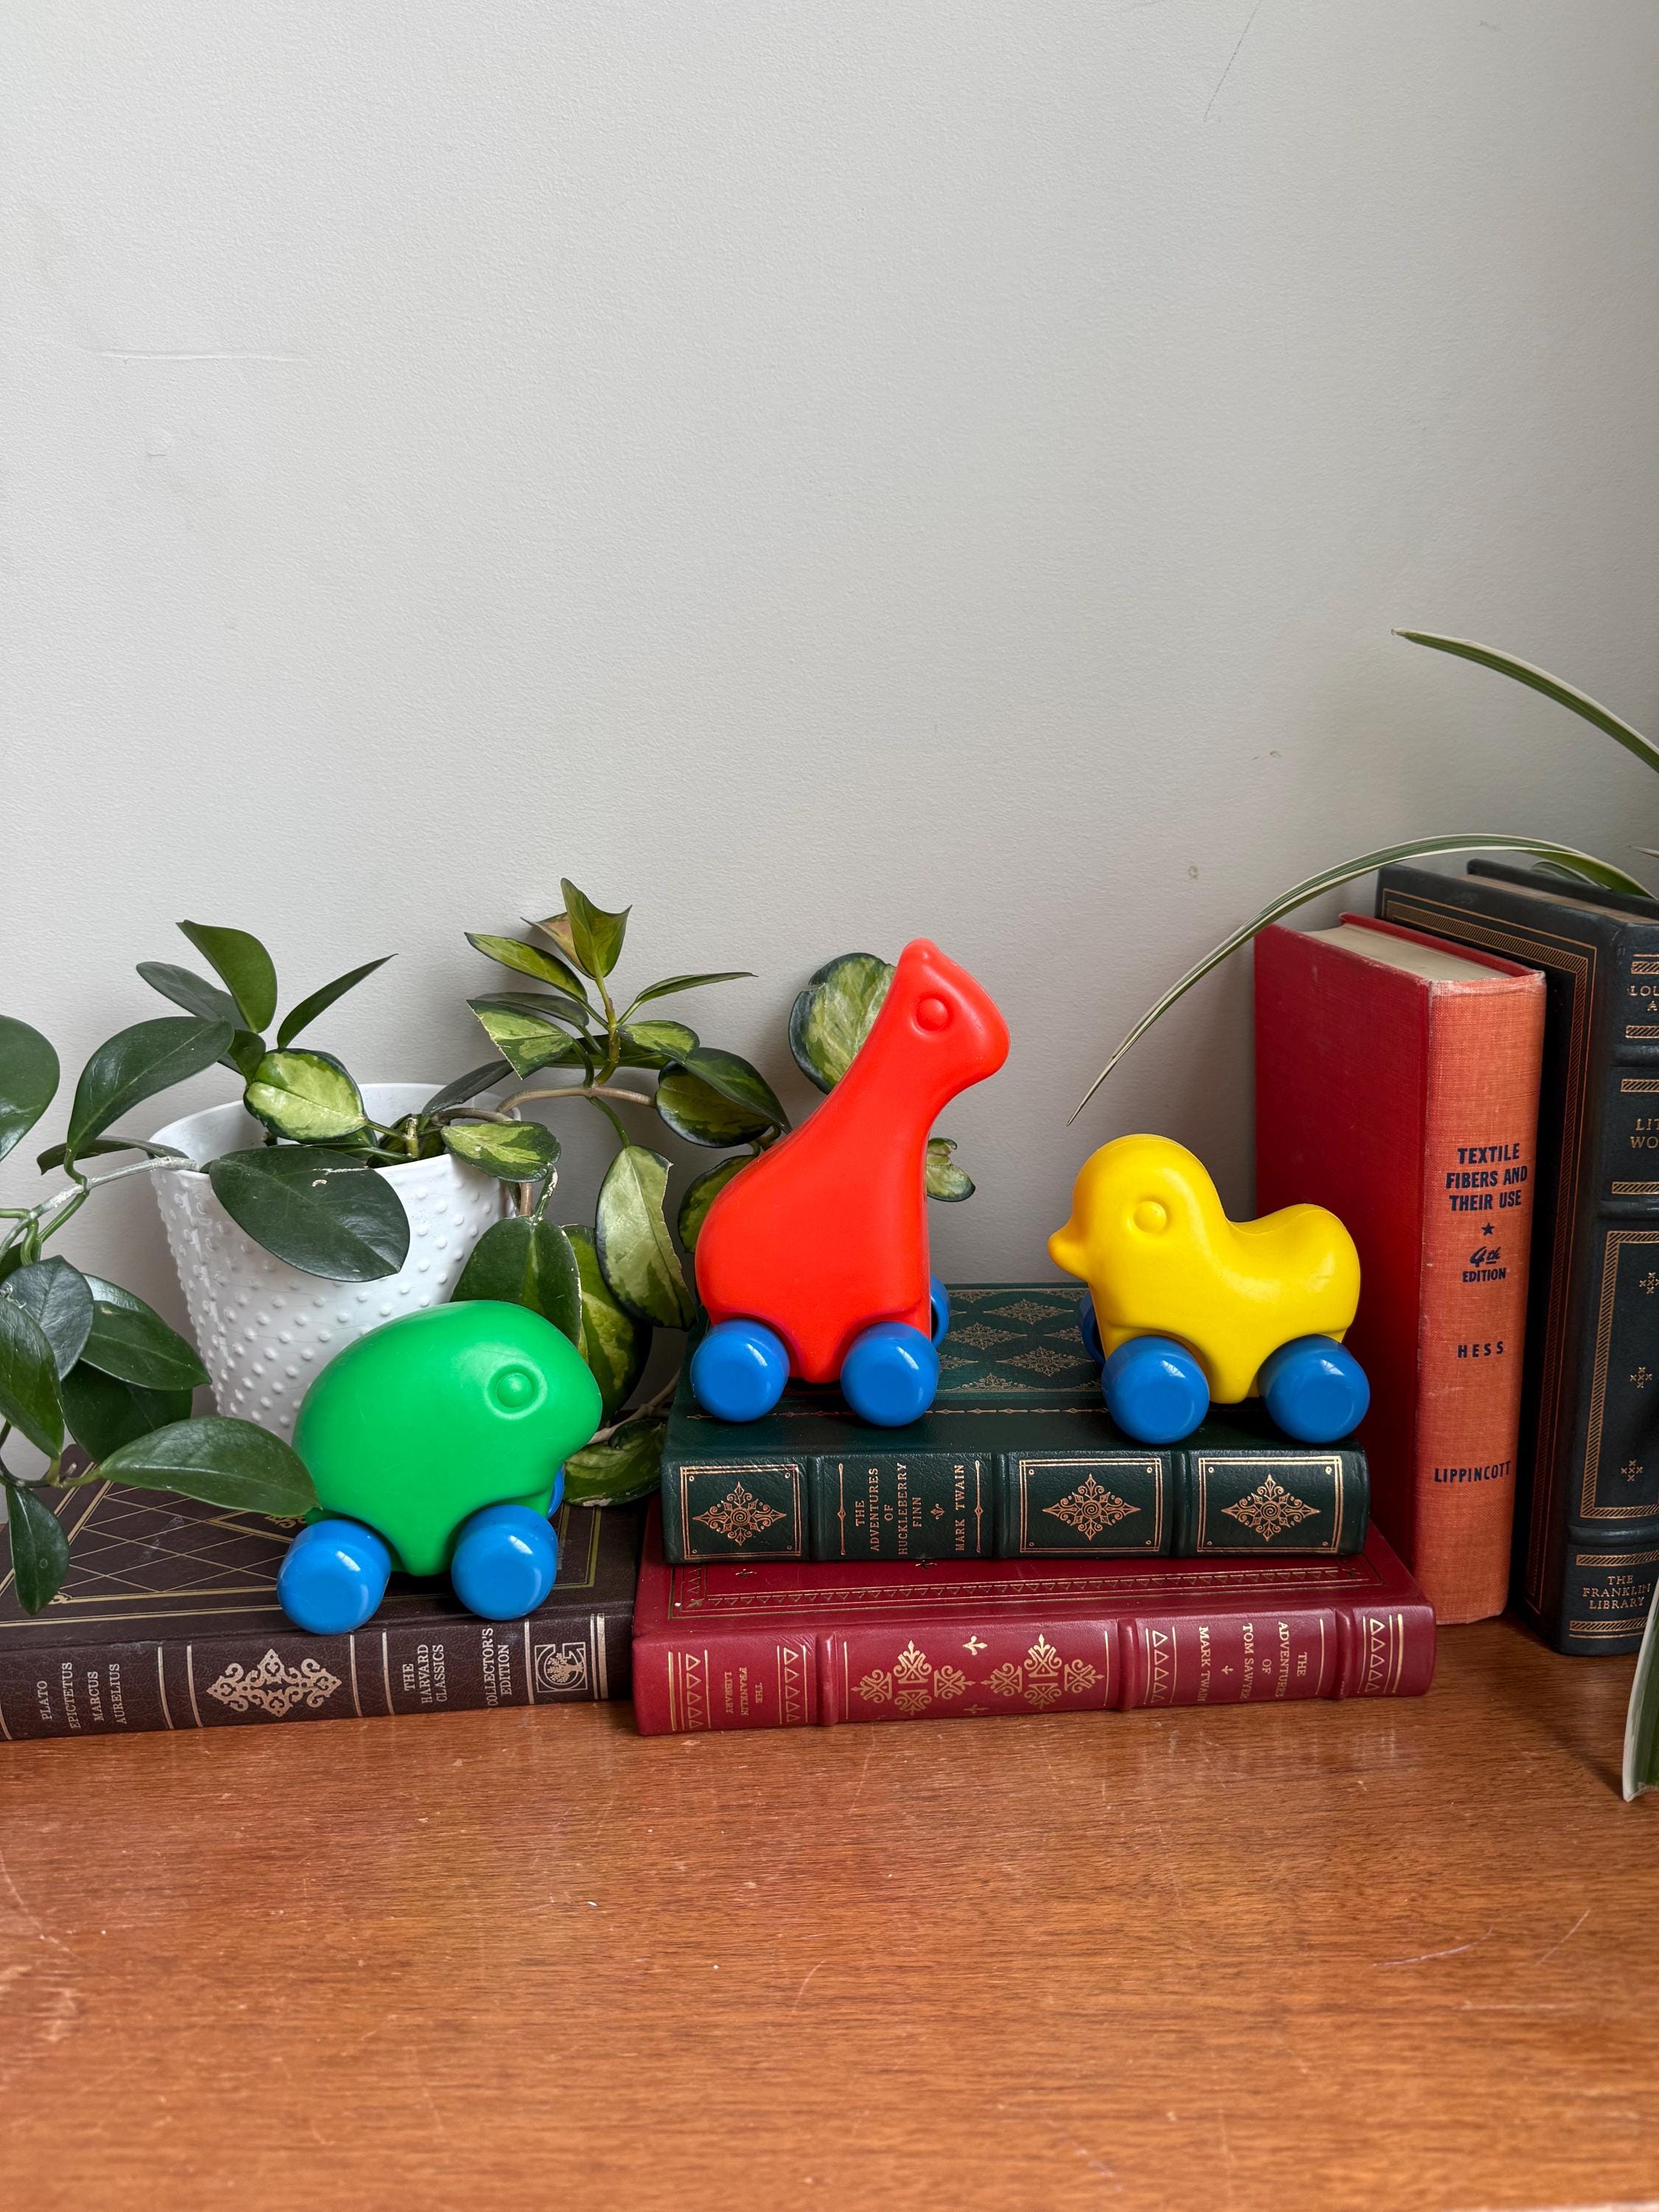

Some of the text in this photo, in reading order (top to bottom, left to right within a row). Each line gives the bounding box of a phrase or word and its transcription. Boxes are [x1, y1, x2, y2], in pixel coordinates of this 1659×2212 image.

[1457, 1143, 1520, 1164] TEXTILE
[1445, 1166, 1528, 1189] FIBERS AND
[1449, 1189, 1522, 1211] THEIR USE
[1470, 1246, 1500, 1267] 4th
[1462, 1267, 1506, 1283] EDITION
[1457, 1341, 1504, 1358] HESS
[1434, 1460, 1512, 1484] LIPPINCOTT
[855, 1500, 866, 1526] THE
[869, 1468, 879, 1551] ADVENTURES
[884, 1504, 894, 1521] OF
[897, 1462, 908, 1555] HUCKLEBERRY
[911, 1496, 922, 1528] FINN
[954, 1464, 966, 1551] MARK TWAIN
[1582, 1583, 1651, 1597] FRANKLIN
[1607, 1575, 1634, 1585] THE
[1589, 1597, 1644, 1609] LIBRARY
[1198, 1626, 1211, 1667] MARK
[1242, 1622, 1254, 1655] TOM
[403, 1663, 416, 1691] THE
[417, 1644, 434, 1704] HARVARD
[431, 1644, 448, 1703] CLASSICS
[481, 1627, 499, 1707] COLLECTOR'S
[498, 1644, 512, 1696] EDITION
[1262, 1658, 1272, 1674] OF
[1296, 1652, 1307, 1676] THE
[37, 1680, 52, 1721] PLATO
[62, 1662, 80, 1728] EPICTETUS
[88, 1671, 104, 1722] MARCUS
[108, 1663, 128, 1725] AURELIUS
[724, 1671, 734, 1713] LIBRARY
[739, 1666, 749, 1715] FRANKLIN
[755, 1682, 763, 1703] THE
